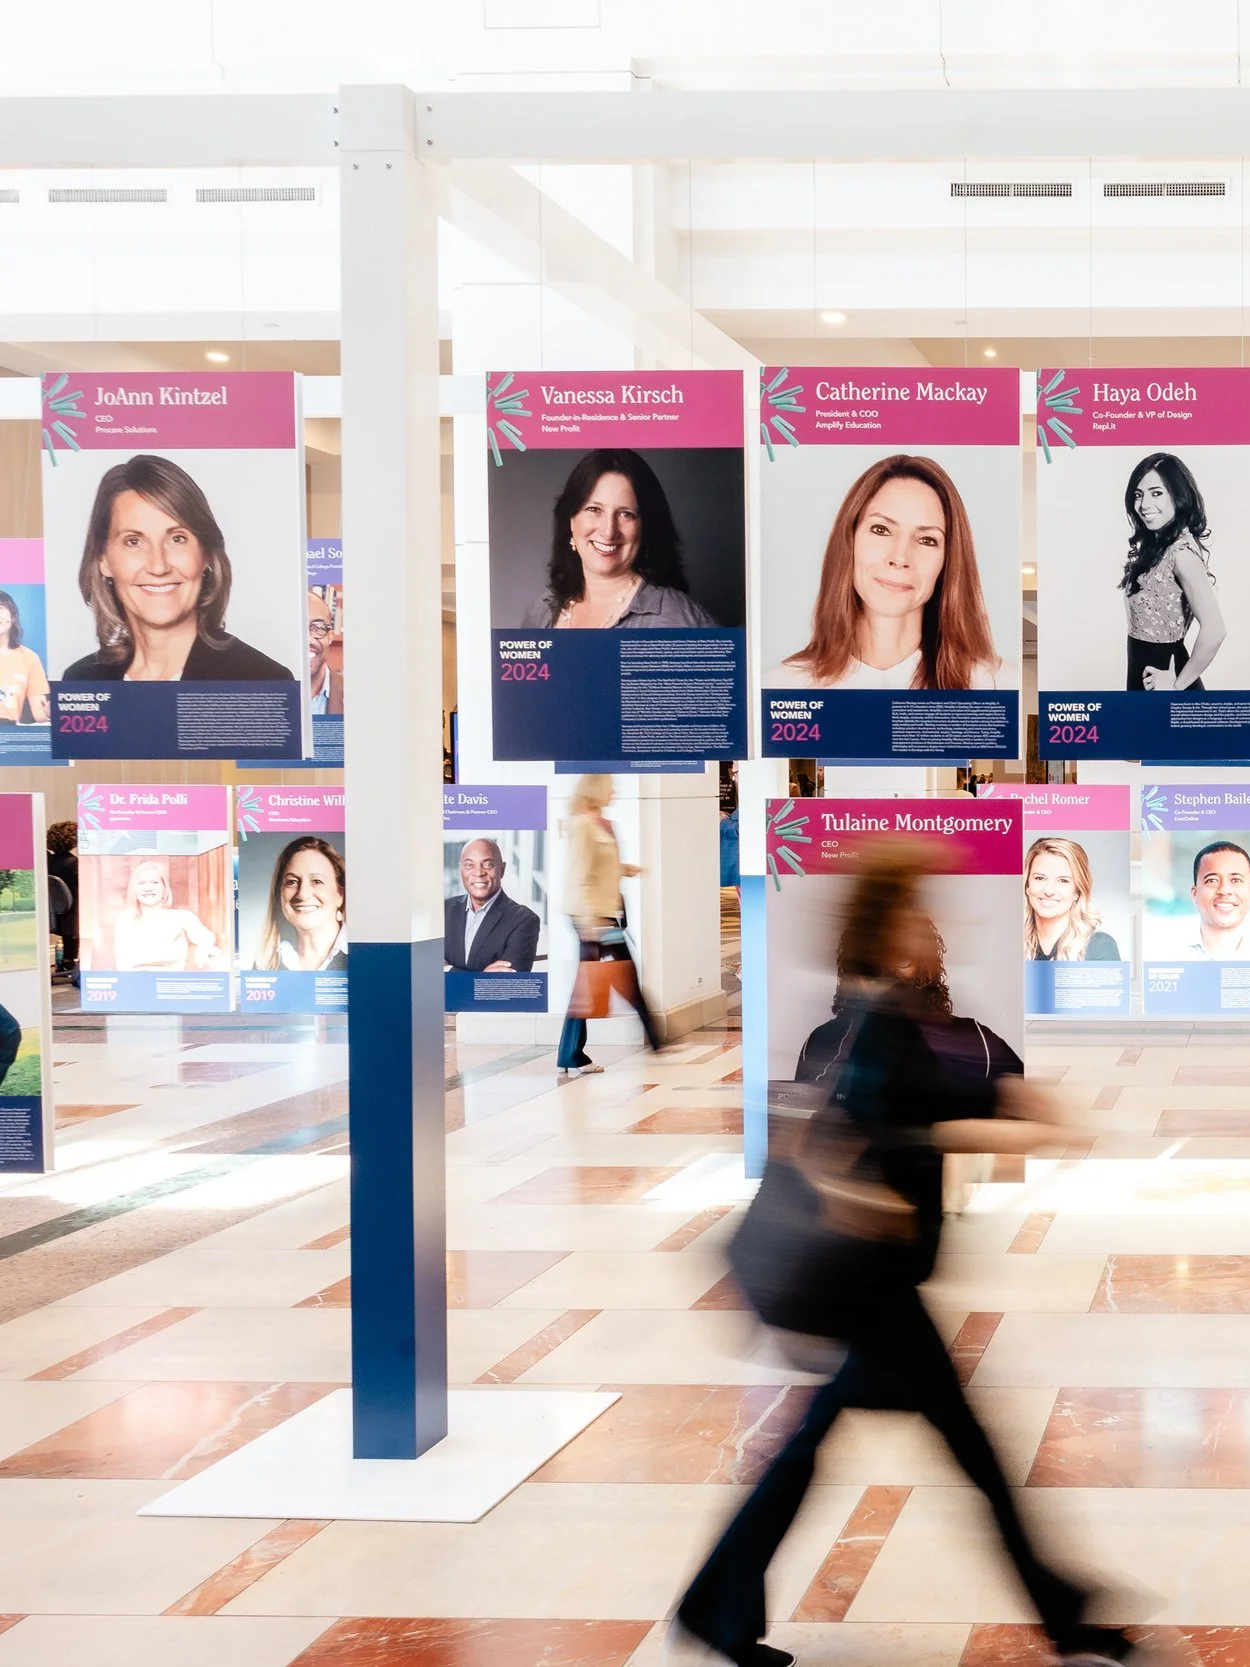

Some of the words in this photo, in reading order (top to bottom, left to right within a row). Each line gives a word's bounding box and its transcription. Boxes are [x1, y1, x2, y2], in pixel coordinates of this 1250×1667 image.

[94, 387, 154, 406] JoAnn
[159, 386, 228, 406] Kintzel
[540, 385, 615, 405] Vanessa
[621, 384, 685, 404] Kirsch
[816, 381, 911, 402] Catherine
[916, 381, 988, 405] Mackay
[1093, 383, 1141, 407] Haya
[1146, 382, 1197, 402] Odeh
[95, 415, 113, 423] CEO
[541, 413, 619, 422] Founder-in-Residence
[620, 413, 626, 422] &
[628, 413, 651, 421] Senior
[652, 413, 679, 421] Partner
[815, 410, 850, 418] President
[851, 410, 857, 418] &
[859, 410, 878, 418] COO
[1093, 411, 1136, 419] Co-Founder
[1138, 411, 1144, 419] &
[1145, 411, 1156, 419] VP
[1157, 411, 1166, 419] of
[1167, 410, 1193, 421] Design
[124, 426, 158, 434] Solutions
[541, 425, 559, 433] New
[560, 424, 581, 433] Profit
[815, 421, 844, 430] Amplify
[845, 421, 882, 429] Education
[1093, 422, 1116, 431] Repl.it
[500, 641, 537, 650] POWER
[539, 641, 553, 649] OF
[500, 651, 541, 660] WOMEN
[501, 663, 550, 681] 2024
[58, 693, 95, 702] POWER
[96, 693, 111, 701] OF
[58, 703, 99, 712] WOMEN
[770, 701, 807, 709] POWER
[809, 701, 824, 709] OF
[1048, 703, 1085, 712] POWER
[1087, 703, 1102, 711] OF
[770, 711, 812, 720] WOMEN
[1048, 713, 1090, 722] WOMEN
[59, 715, 108, 733] 2024
[771, 723, 821, 741] 2024
[1048, 725, 1099, 744] 2024
[109, 793, 127, 805] Dr.
[162, 793, 188, 805] Polli
[268, 795, 320, 806] Christine
[458, 793, 488, 805] Davis
[1052, 793, 1090, 805] Romer
[1174, 793, 1221, 806] Stephen
[821, 813, 889, 831] Tulaine
[894, 813, 1013, 835] Montgomery
[821, 840, 838, 848] CEO
[821, 851, 838, 859] New
[839, 851, 860, 859] Profit
[1149, 981, 1177, 992] 2021
[87, 990, 117, 1001] 2019
[246, 990, 276, 1001] 2019
